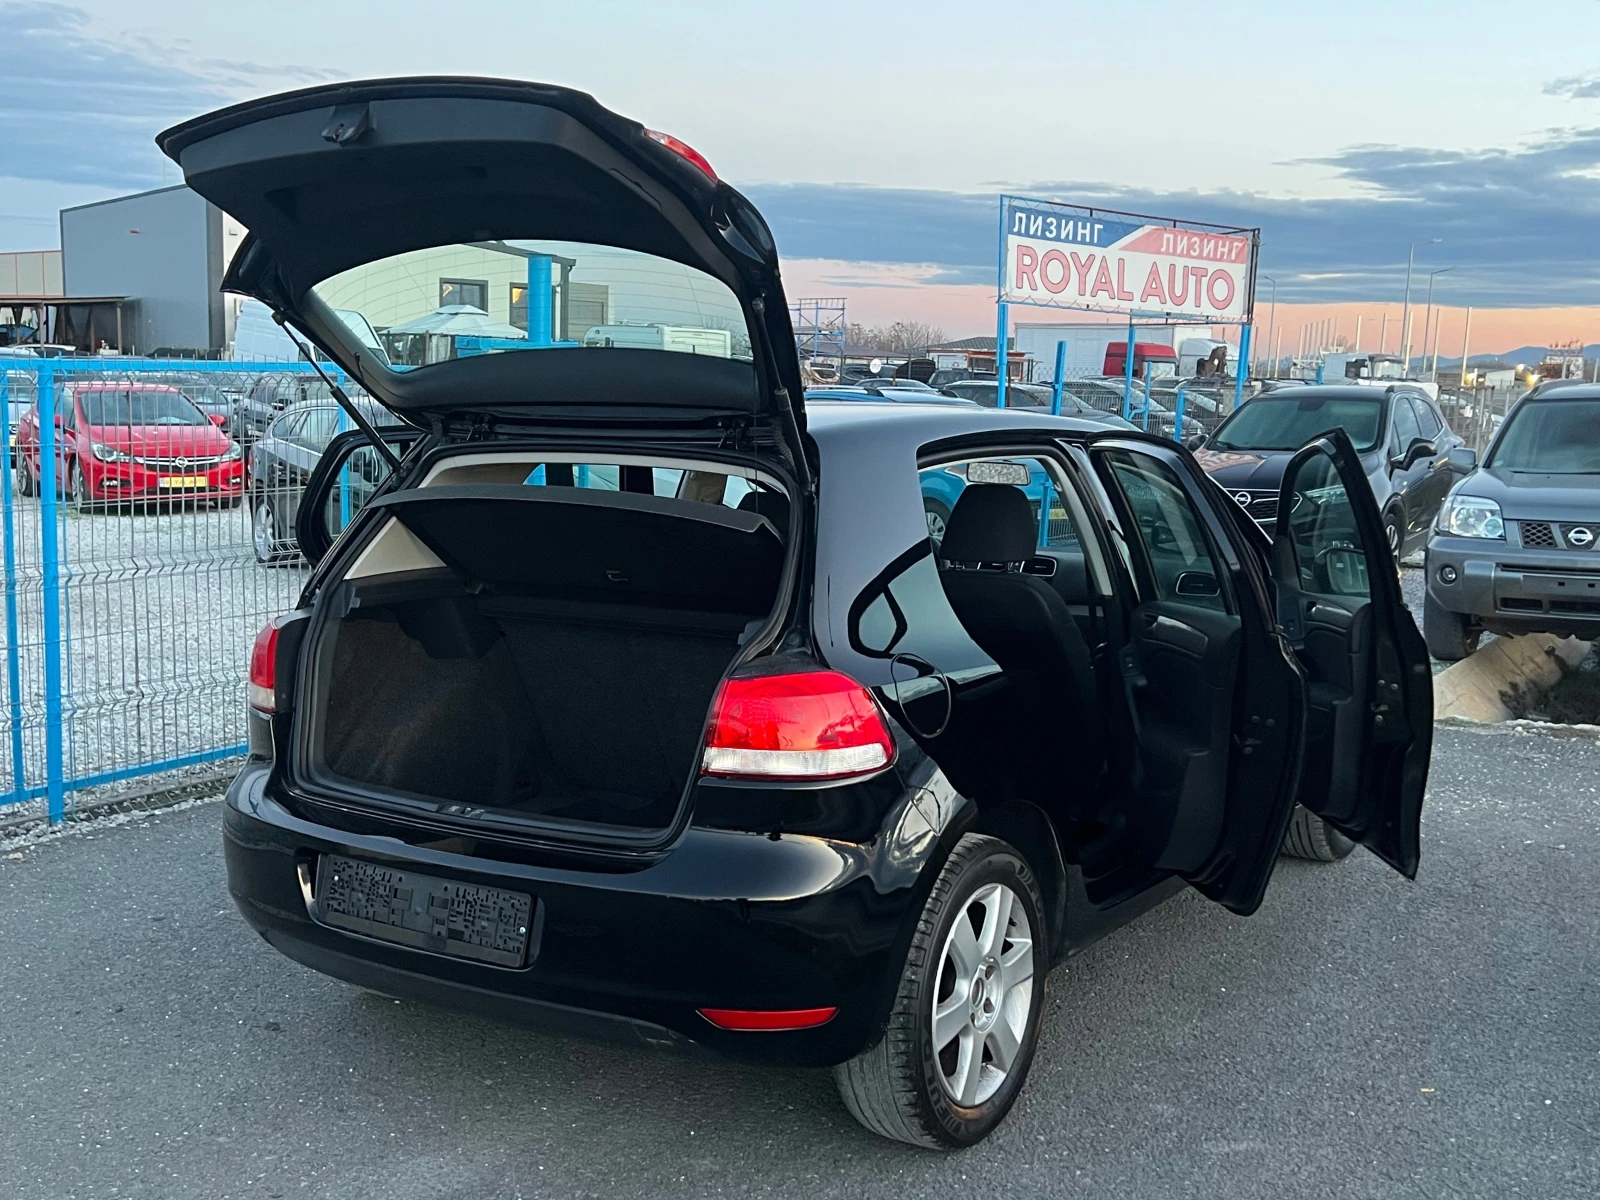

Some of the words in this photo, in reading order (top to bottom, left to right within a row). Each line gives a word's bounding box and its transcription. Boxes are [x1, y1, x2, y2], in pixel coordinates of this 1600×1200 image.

[1013, 212, 1103, 243] ЛИЗИНГ
[1161, 233, 1241, 260] ЛИЗИНГ
[1016, 244, 1134, 301] ROYAL
[1140, 261, 1235, 310] AUTO
